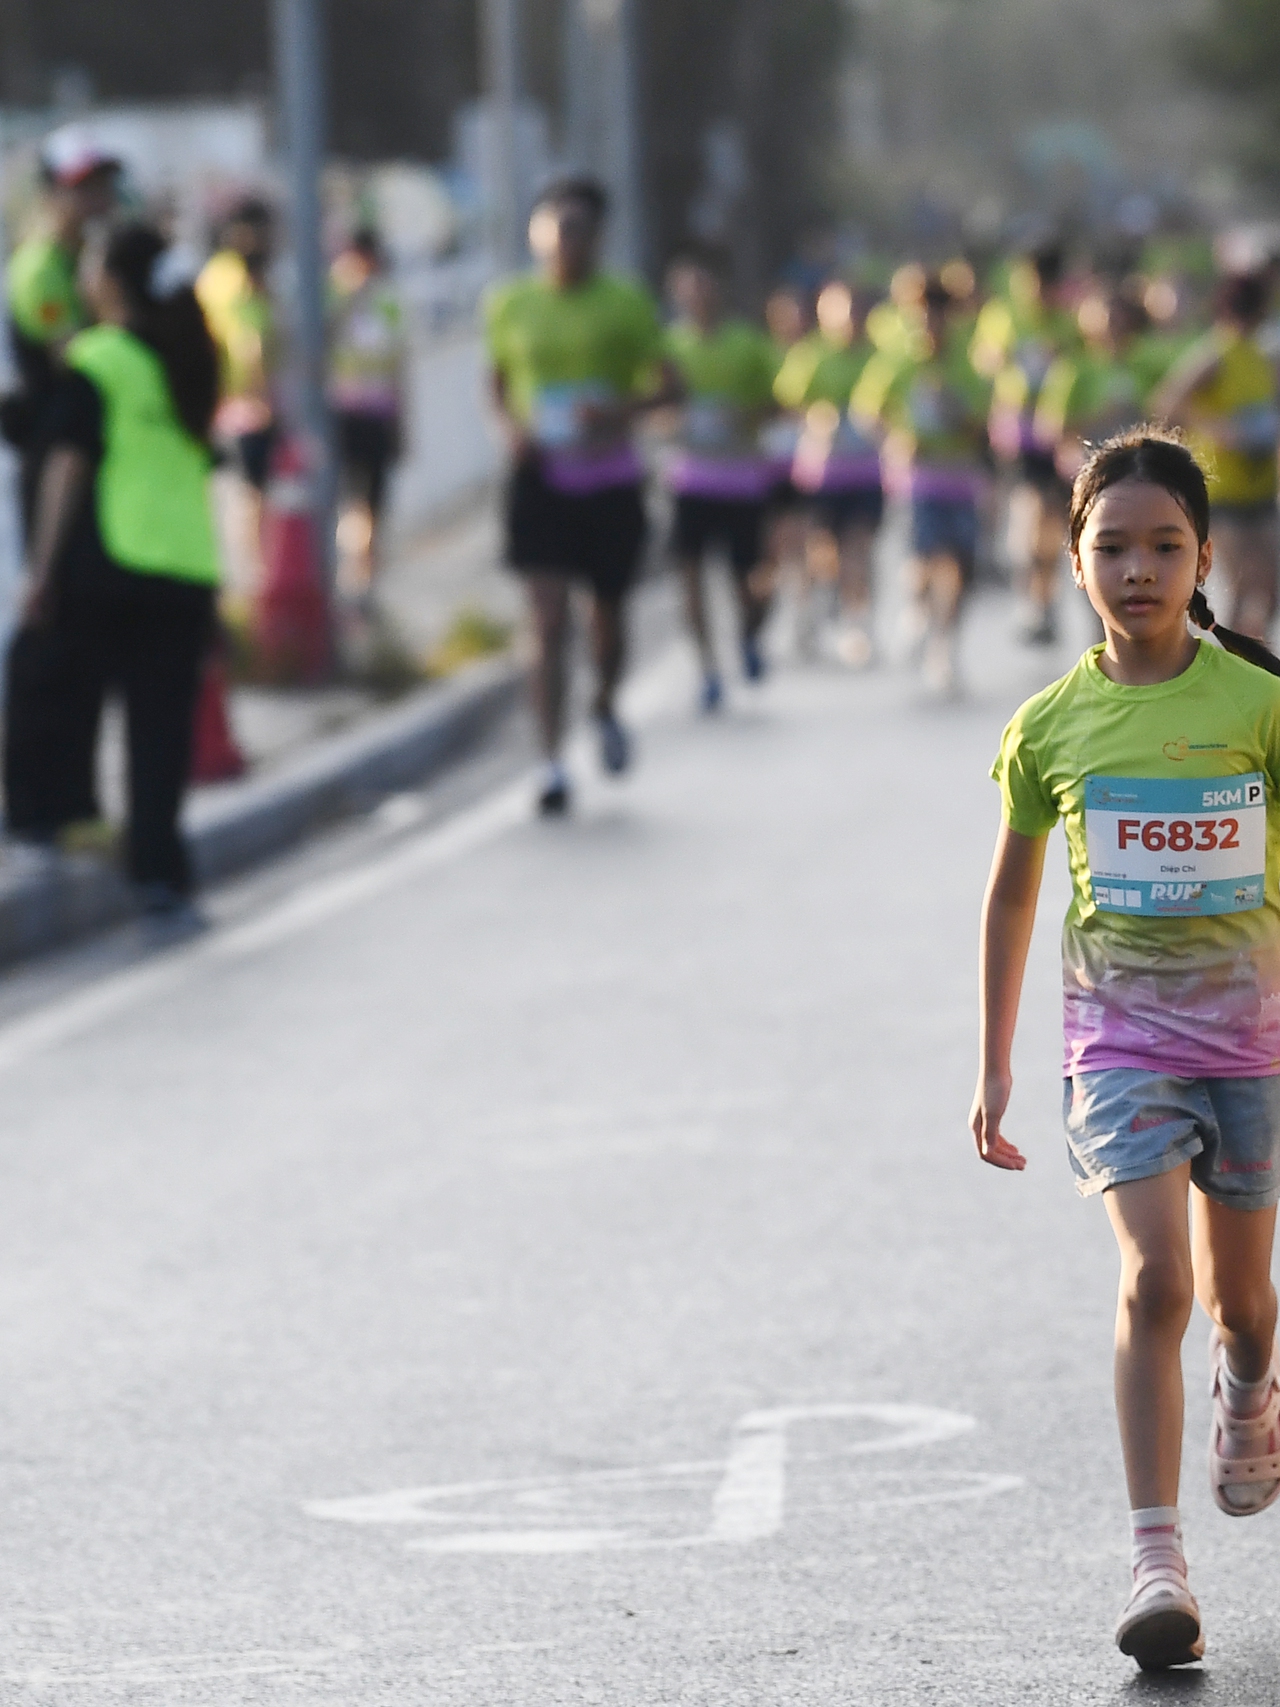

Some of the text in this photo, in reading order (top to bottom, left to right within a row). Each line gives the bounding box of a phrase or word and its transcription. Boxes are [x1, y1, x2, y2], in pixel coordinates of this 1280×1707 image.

[1202, 786, 1261, 807] 5KM P
[1118, 818, 1240, 852] F6832
